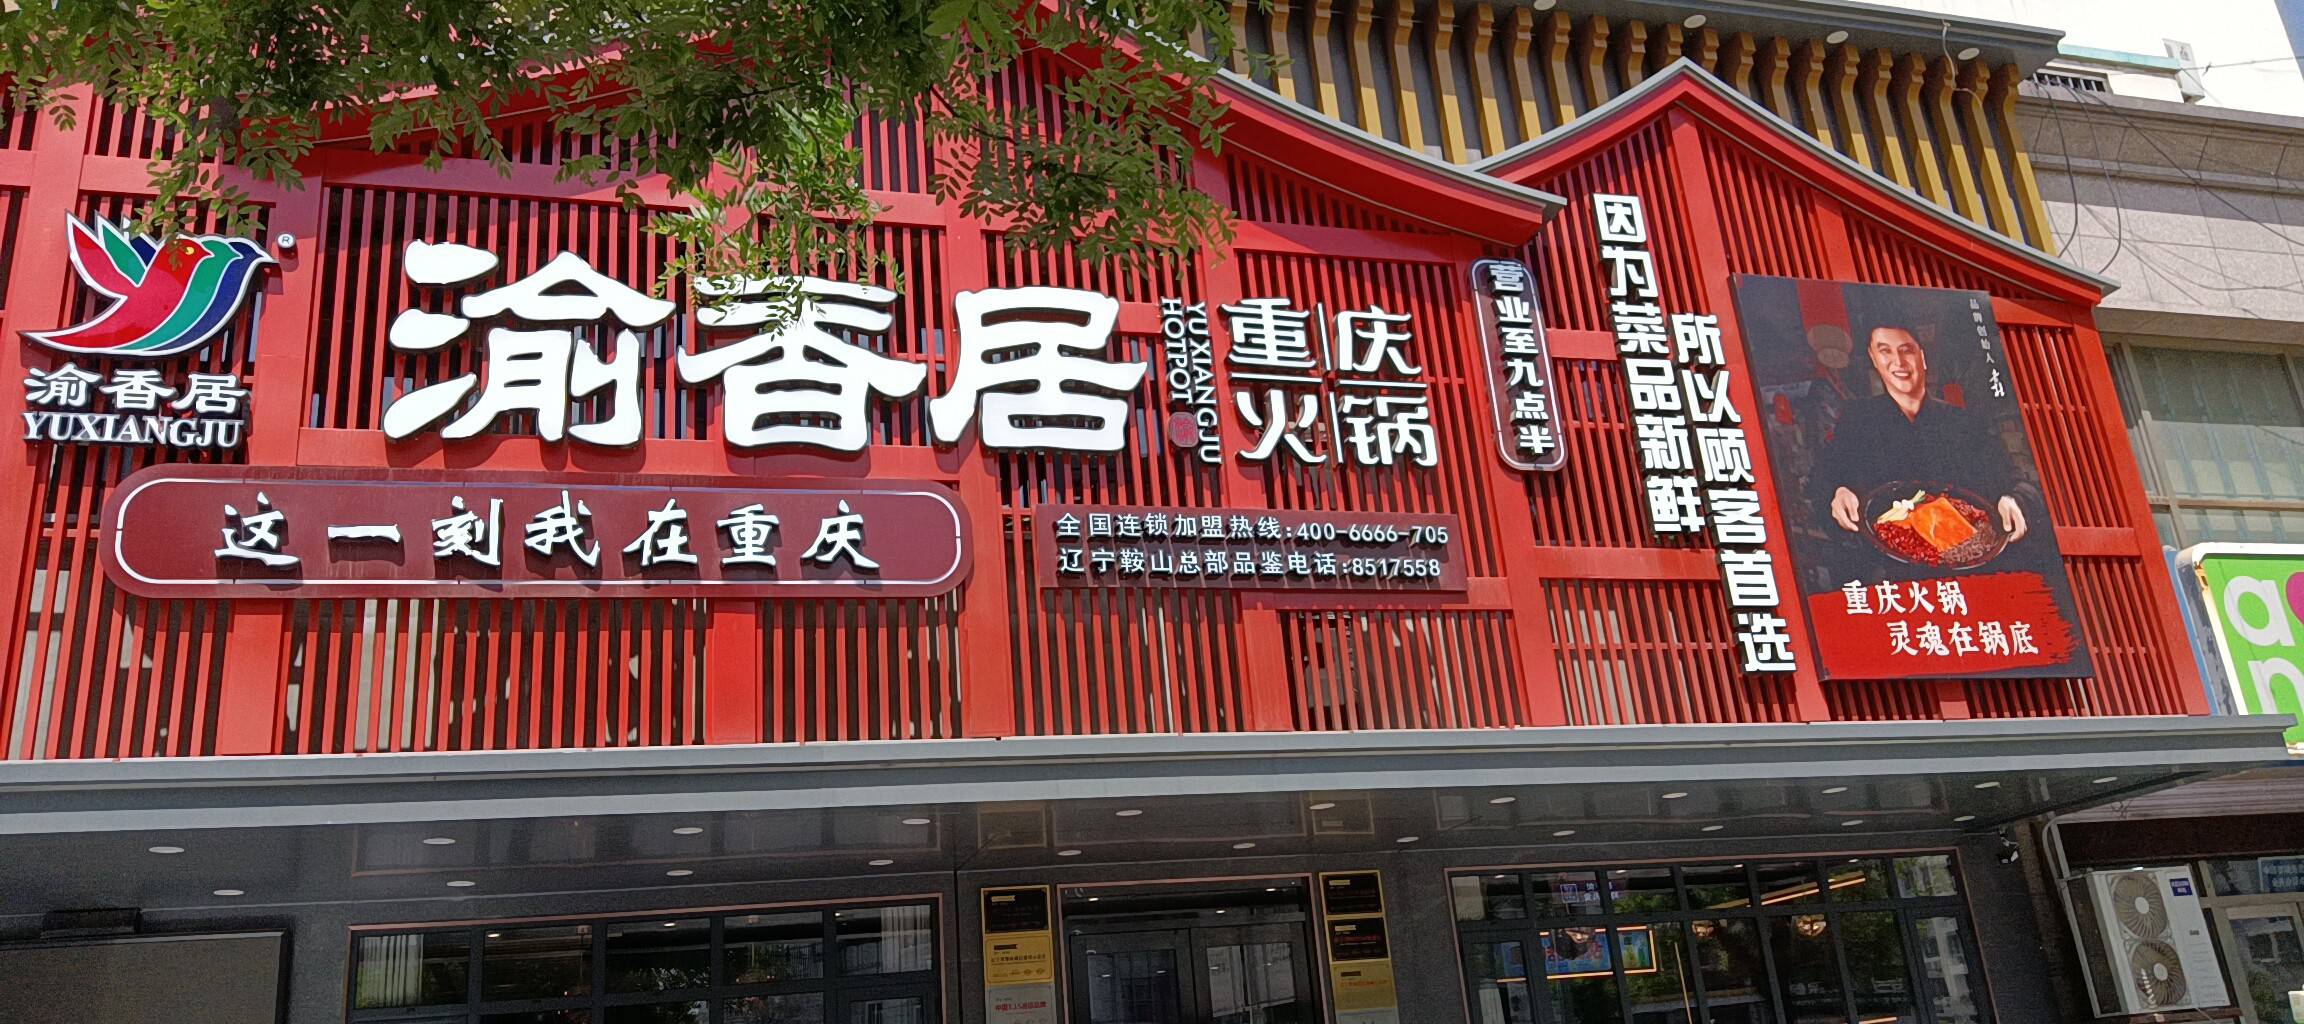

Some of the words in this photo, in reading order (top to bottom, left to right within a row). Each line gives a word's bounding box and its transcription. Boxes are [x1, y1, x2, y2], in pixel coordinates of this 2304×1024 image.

[24, 363, 248, 413] 渝香居
[382, 239, 1148, 452] 渝香居
[1160, 296, 1194, 404] HOTPOT
[1488, 264, 1555, 454] 营业至九点半
[1593, 193, 1705, 534] 因为菜品新鲜
[22, 411, 245, 449] YUXIANGJU
[214, 489, 880, 569] 这一刻我在重庆
[1670, 312, 1796, 672] 所以顾客首选
[1842, 579, 1968, 616] 重庆火锅
[1886, 620, 2039, 656] 灵魂在锅底
